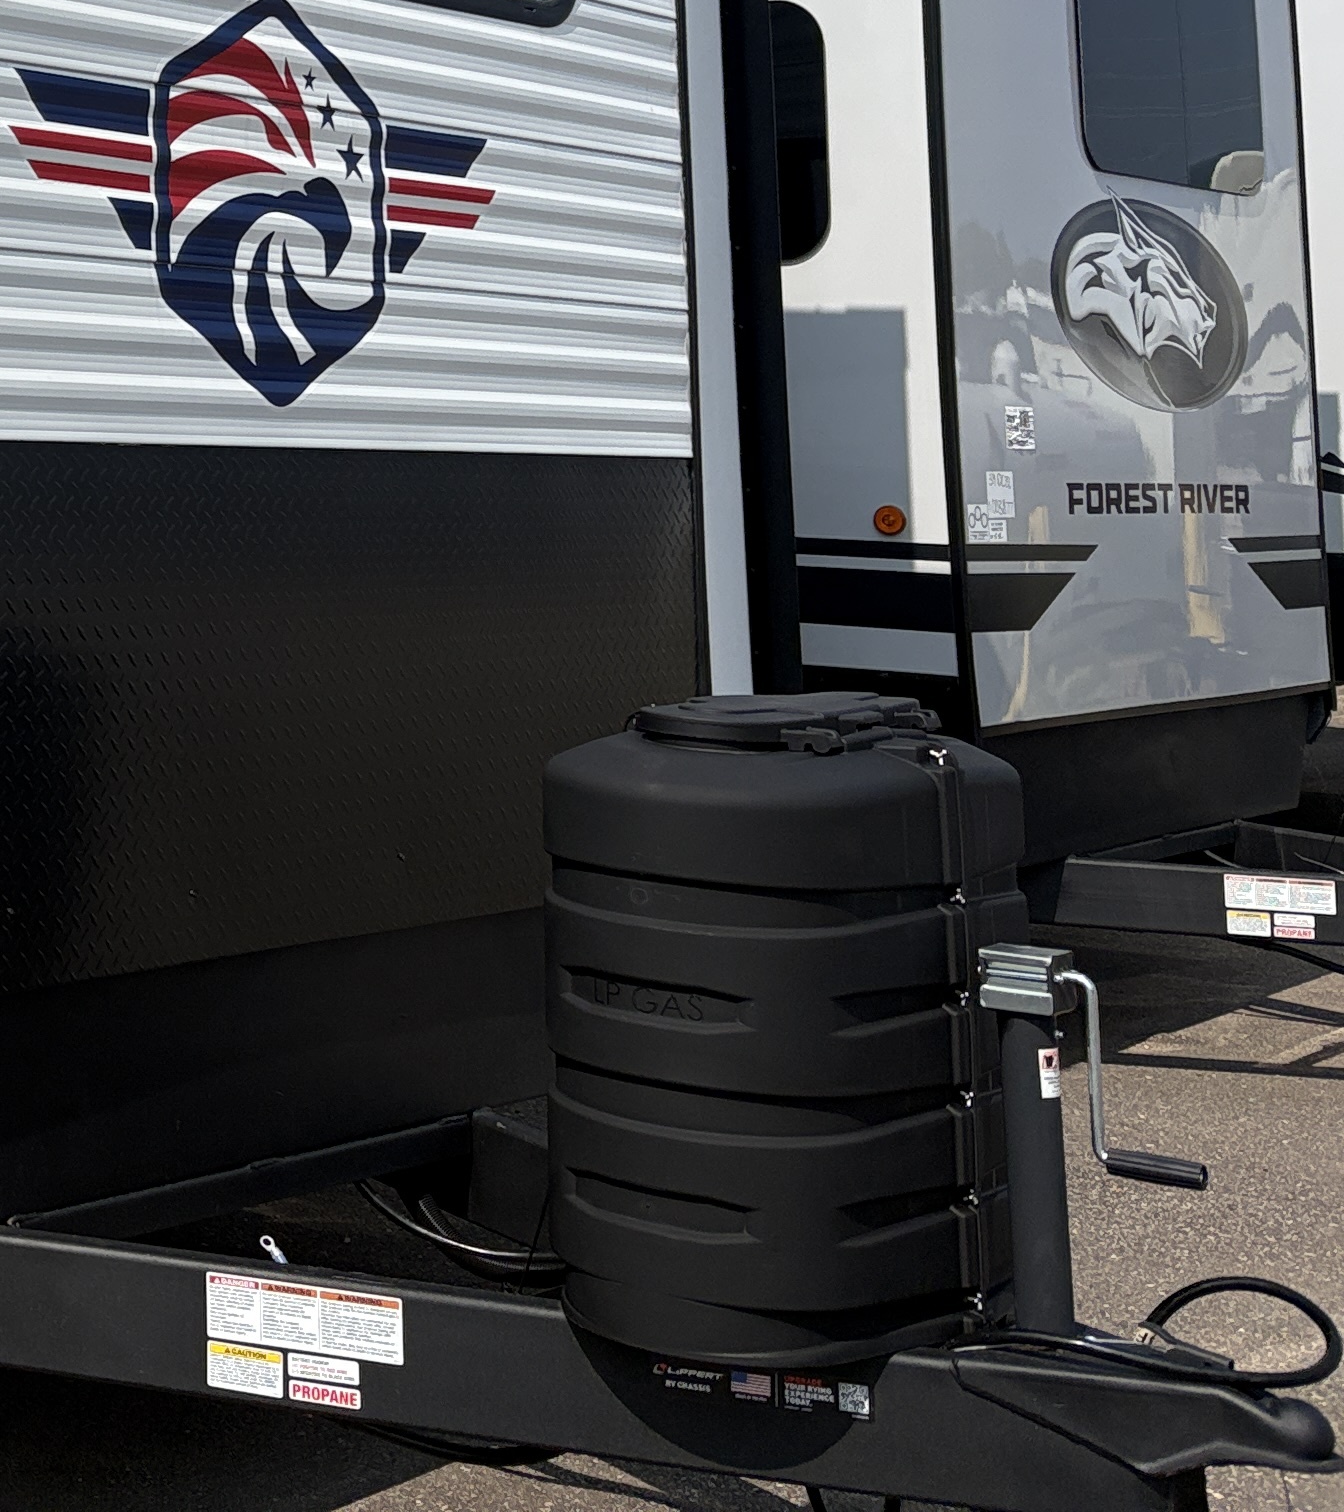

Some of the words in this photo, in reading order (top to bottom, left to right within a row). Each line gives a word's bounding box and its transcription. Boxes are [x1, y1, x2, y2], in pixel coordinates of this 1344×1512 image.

[1066, 482, 1173, 515] FOREST
[1178, 482, 1251, 515] RIVER
[593, 977, 621, 1006] LP
[631, 986, 704, 1022] GAS
[231, 1348, 267, 1361] CAUTION
[292, 1383, 358, 1407] PROPANE
